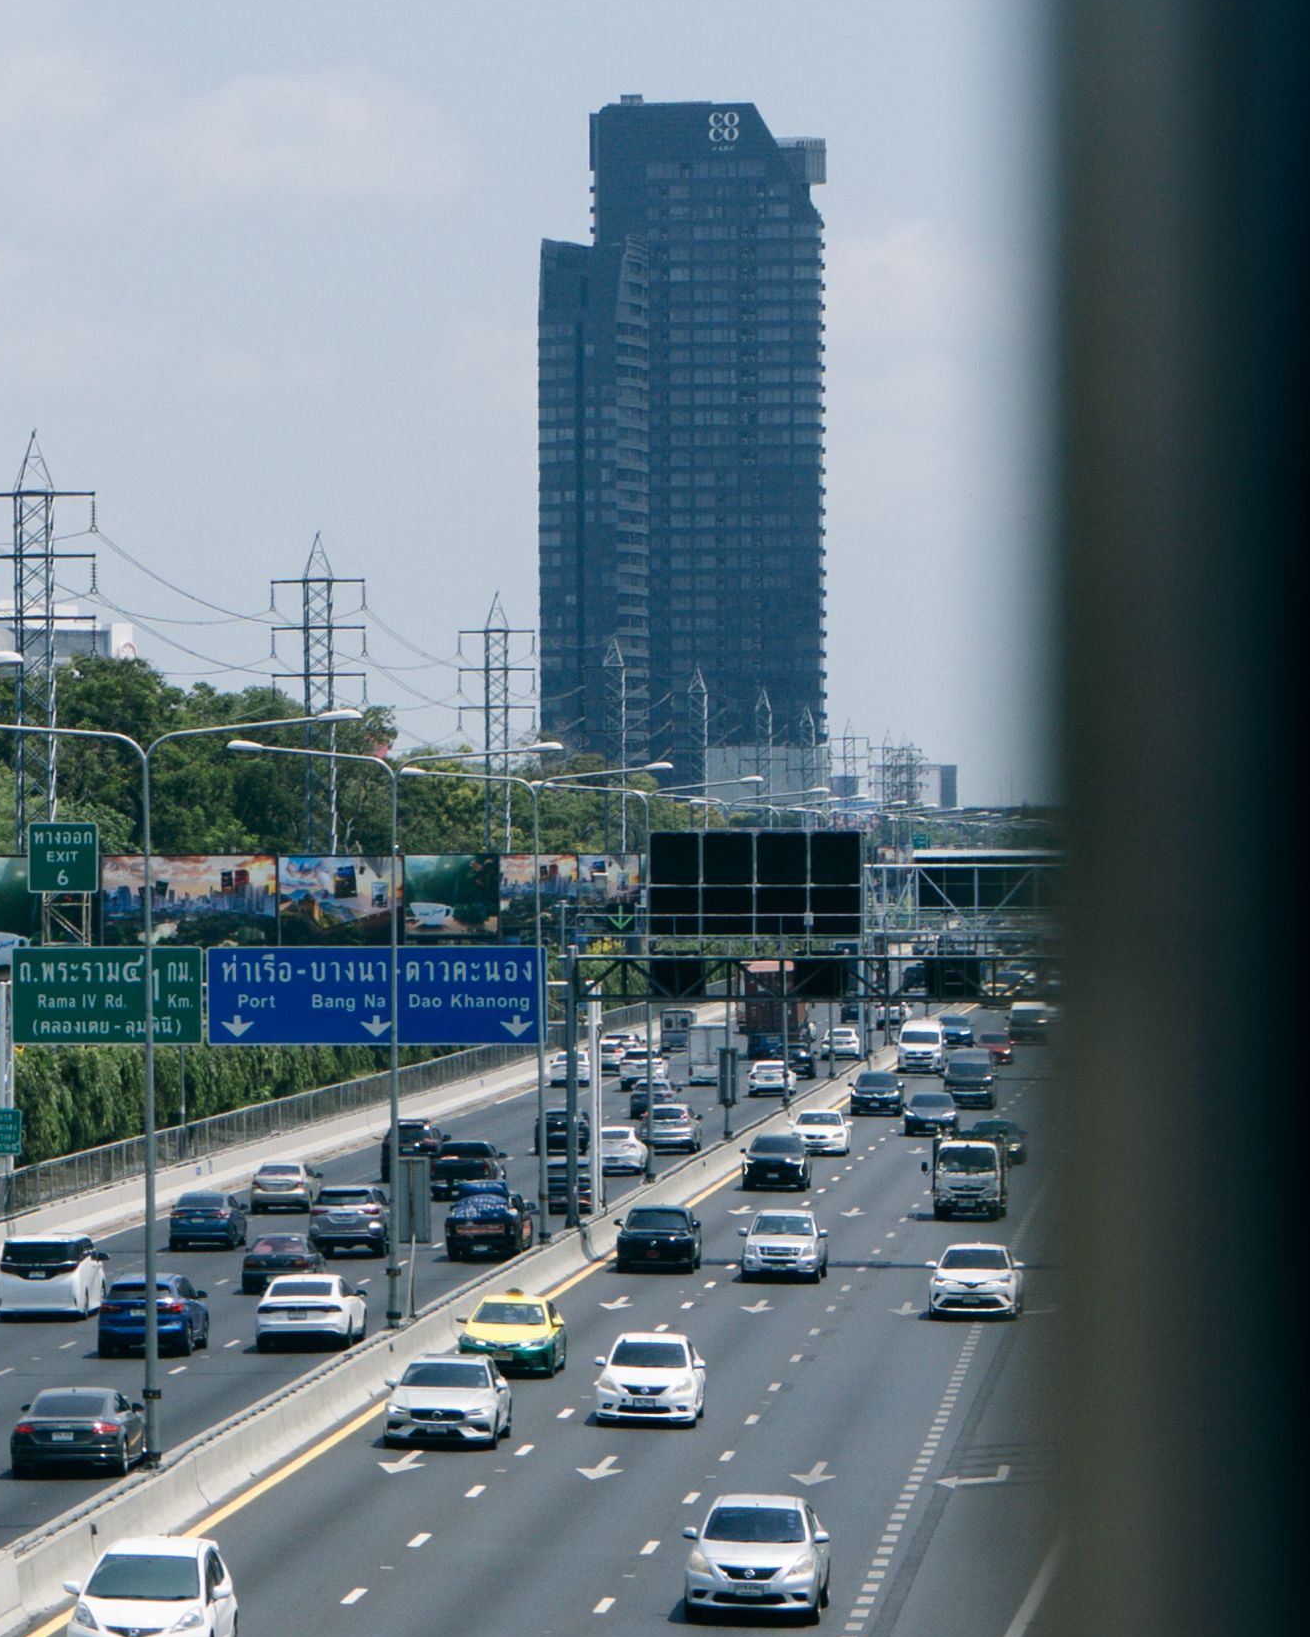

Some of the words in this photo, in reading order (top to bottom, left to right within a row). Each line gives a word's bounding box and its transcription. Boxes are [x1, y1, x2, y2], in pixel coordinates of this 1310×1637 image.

[33, 830, 93, 844] ทางออก
[46, 851, 78, 862] EXIT
[57, 870, 69, 886] 6
[19, 954, 145, 983] ถ.พระราม๔
[153, 969, 160, 1001] 1
[167, 962, 194, 983] กม.
[37, 994, 76, 1008] Rama
[82, 994, 97, 1008] IV
[104, 994, 127, 1008] Rd.
[167, 994, 194, 1008] Km.
[237, 994, 276, 1009] Port
[311, 994, 356, 1011] Bang
[364, 994, 386, 1009] Na
[408, 994, 442, 1008] Dao
[451, 994, 530, 1011] Khanong
